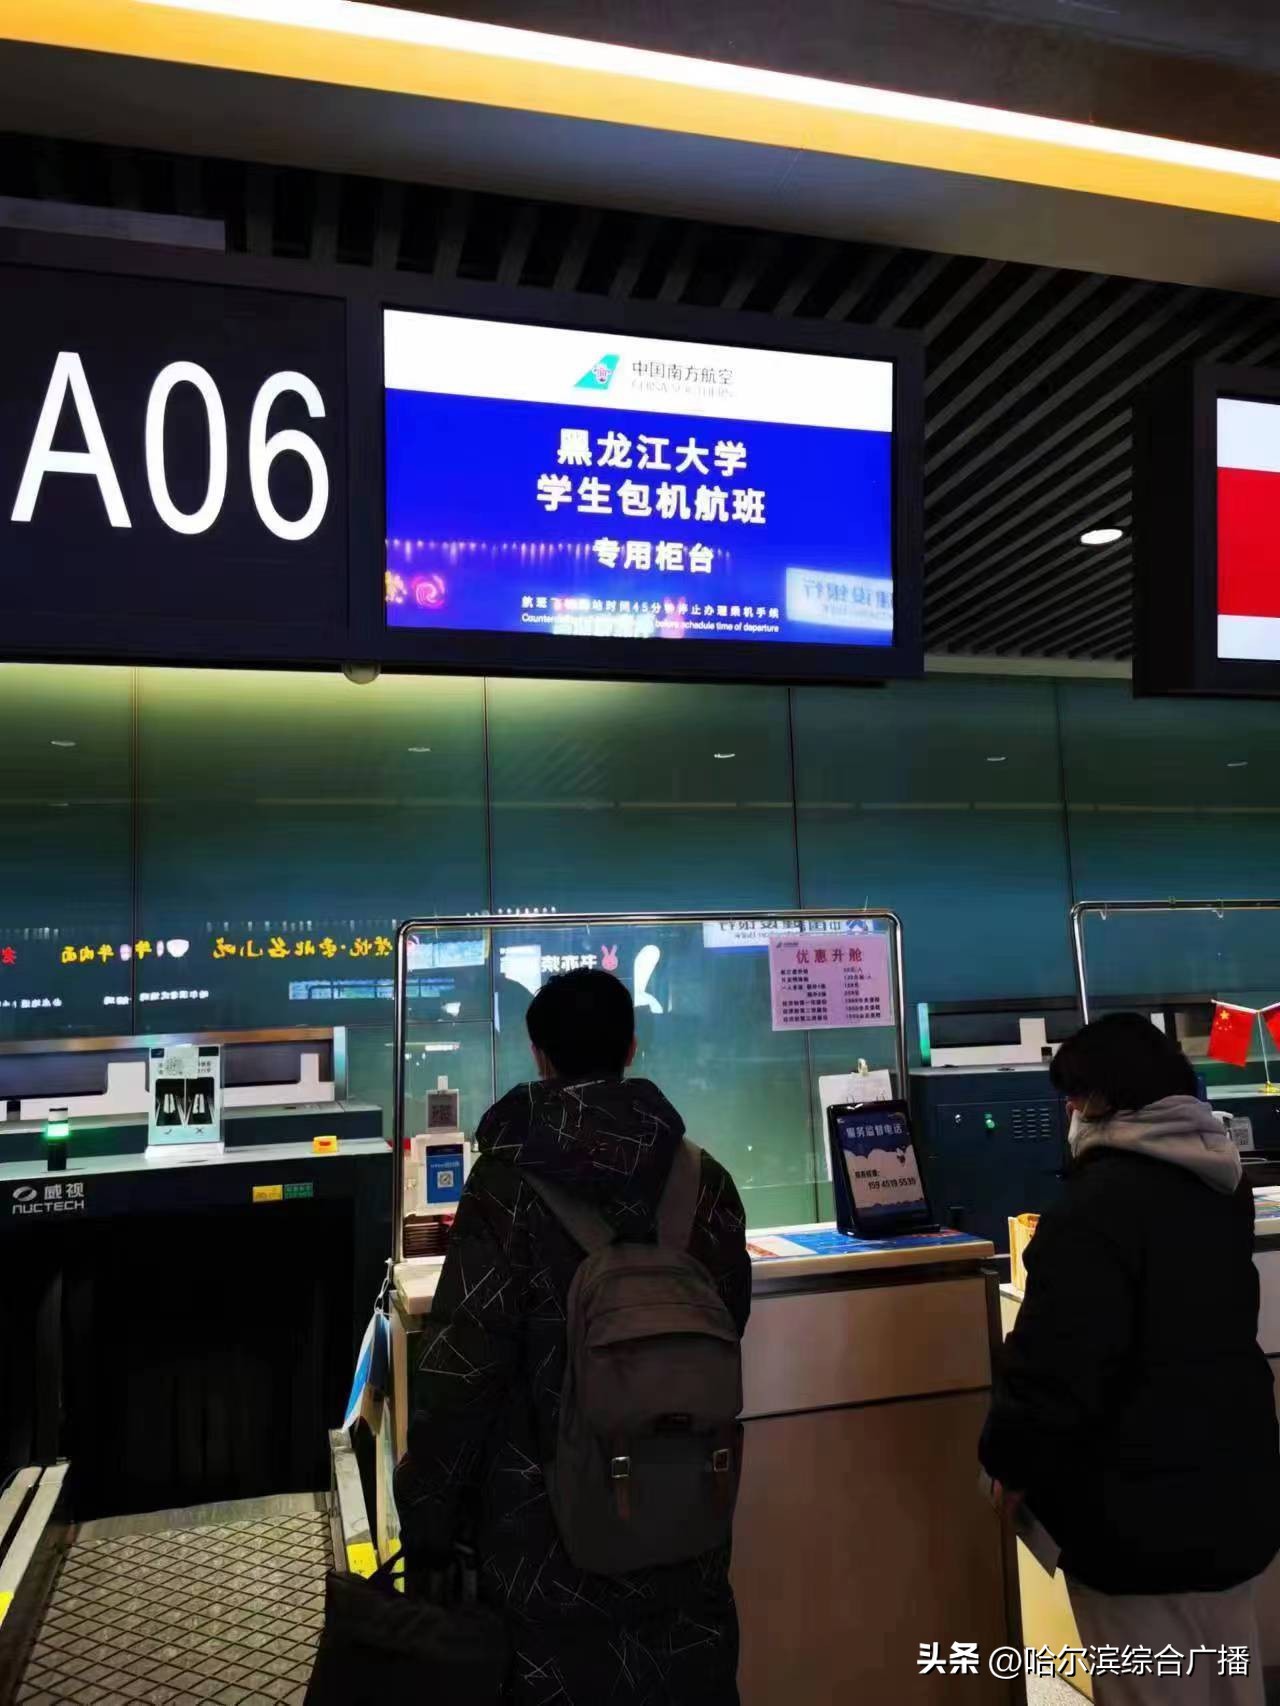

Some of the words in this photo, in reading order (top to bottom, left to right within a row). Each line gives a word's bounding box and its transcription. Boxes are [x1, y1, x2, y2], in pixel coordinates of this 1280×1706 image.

[631, 359, 734, 385] 中国南方航空
[11, 350, 330, 541] A06
[556, 427, 748, 477] 黑龙江大学
[536, 473, 767, 524] 学生包机航班
[592, 537, 715, 574] 专用柜台
[716, 621, 733, 631] time
[734, 622, 742, 631] of
[795, 947, 864, 964] 优惠升舱
[44, 1182, 85, 1200] 威视
[12, 1199, 85, 1215] NUCTECH
